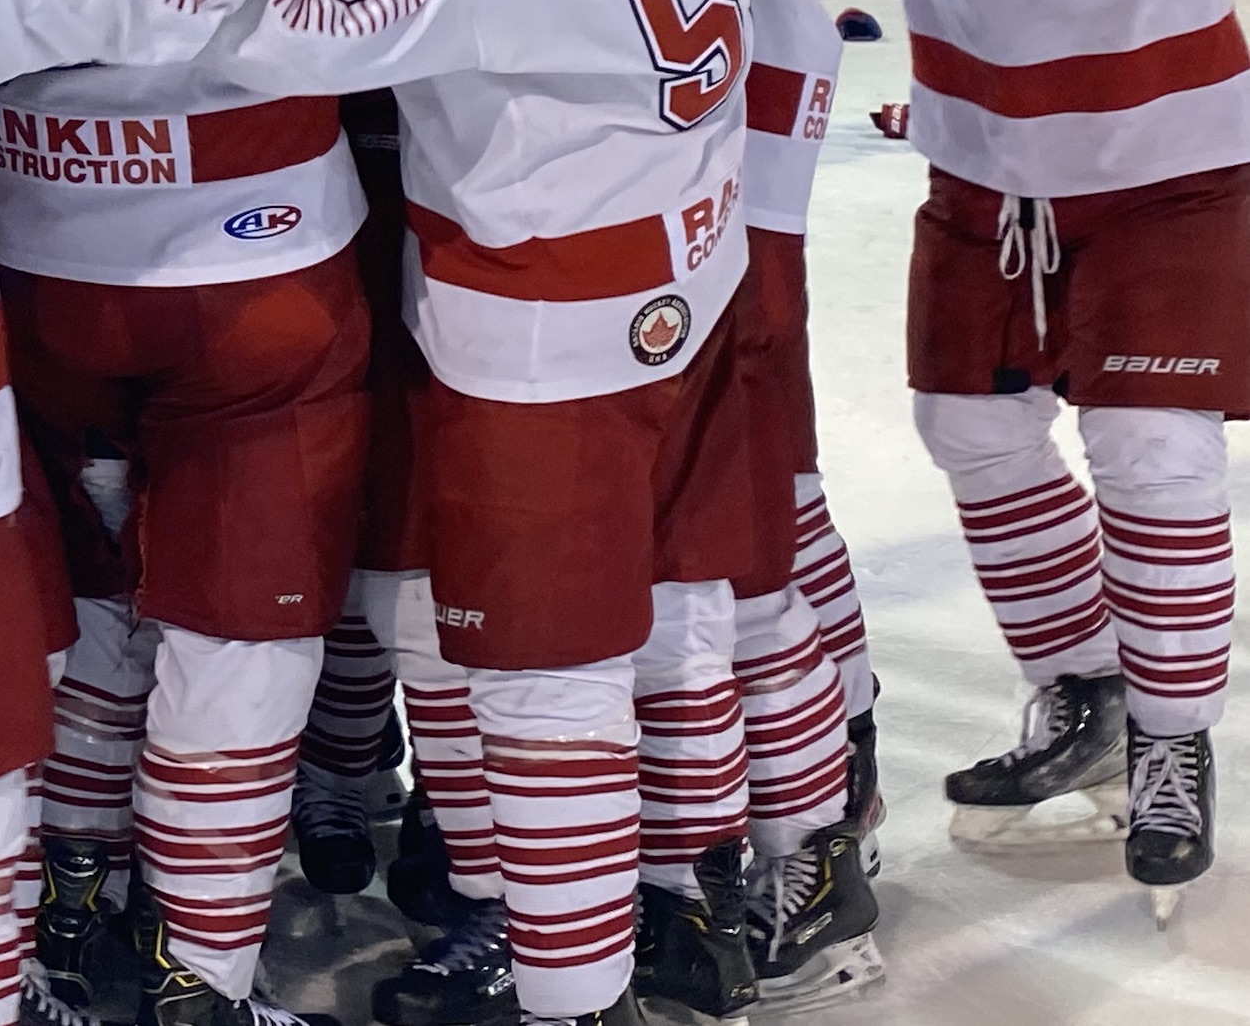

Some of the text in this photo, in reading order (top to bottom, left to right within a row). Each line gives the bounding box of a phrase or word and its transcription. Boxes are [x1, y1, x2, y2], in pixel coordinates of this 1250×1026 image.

[1, 107, 173, 156] NKIN
[229, 207, 300, 236] AK
[1102, 354, 1221, 376] BAUER
